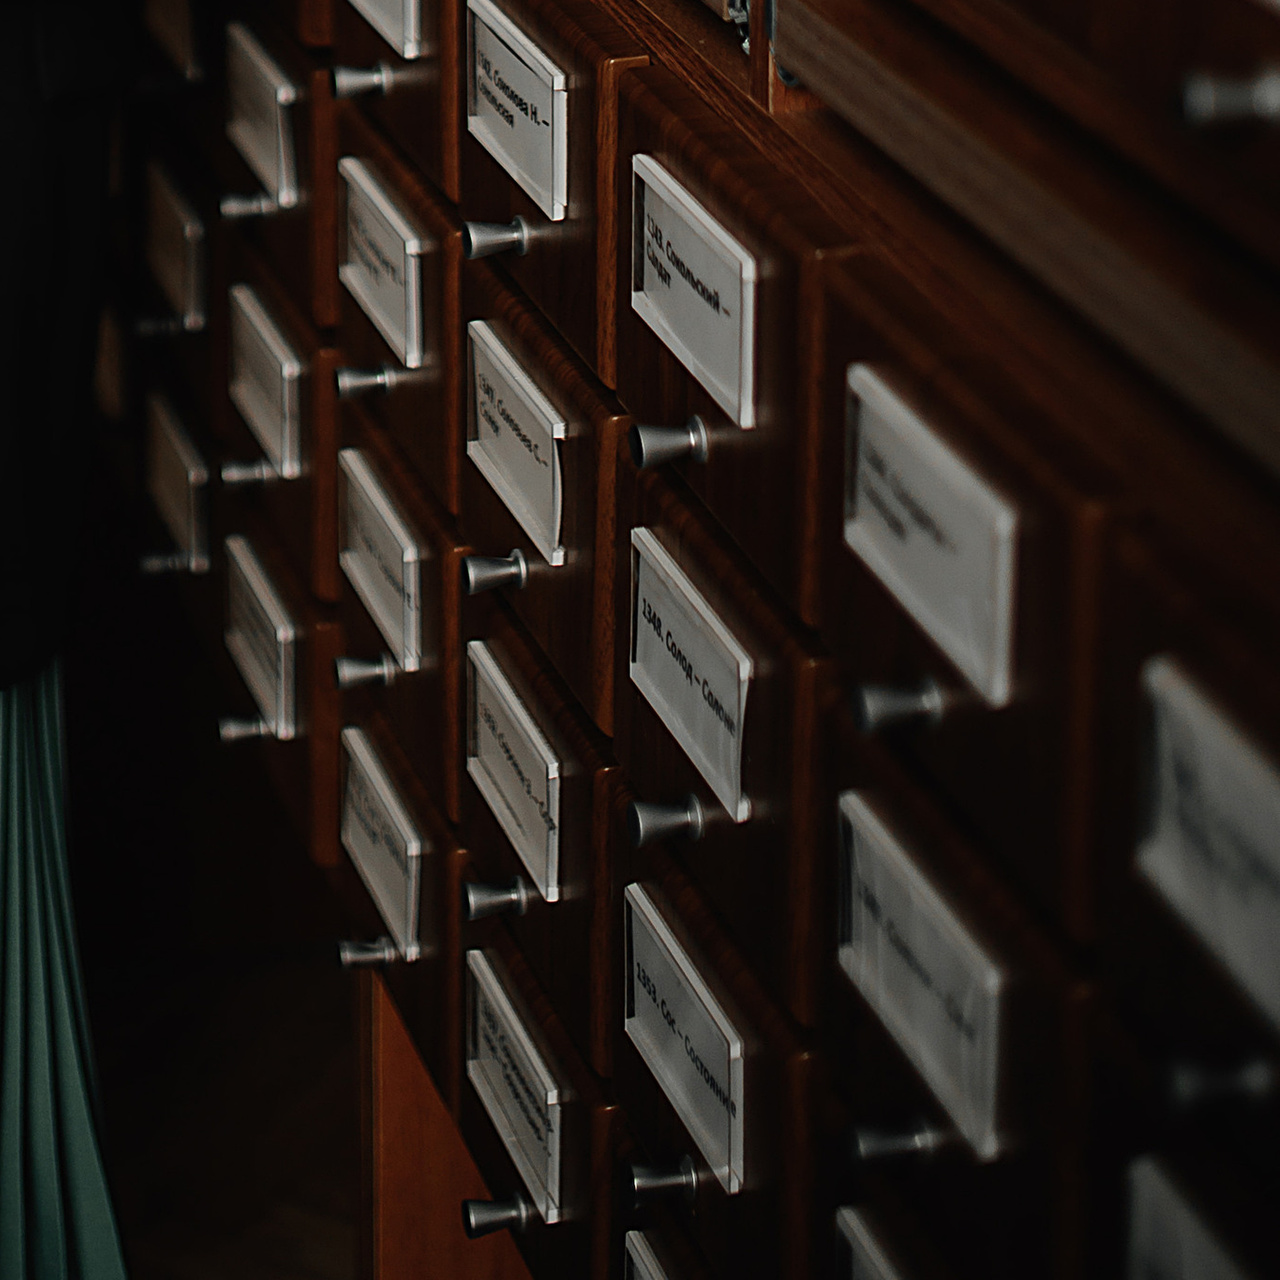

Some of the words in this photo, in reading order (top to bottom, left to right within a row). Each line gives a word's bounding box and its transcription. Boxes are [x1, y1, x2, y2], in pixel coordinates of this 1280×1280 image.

[666, 240, 720, 315] Сокольский
[642, 597, 664, 643] 1348.
[665, 630, 693, 686] Солод
[636, 961, 660, 1009] 1353.
[660, 998, 677, 1036] Сос
[684, 1034, 737, 1119] Состояние
